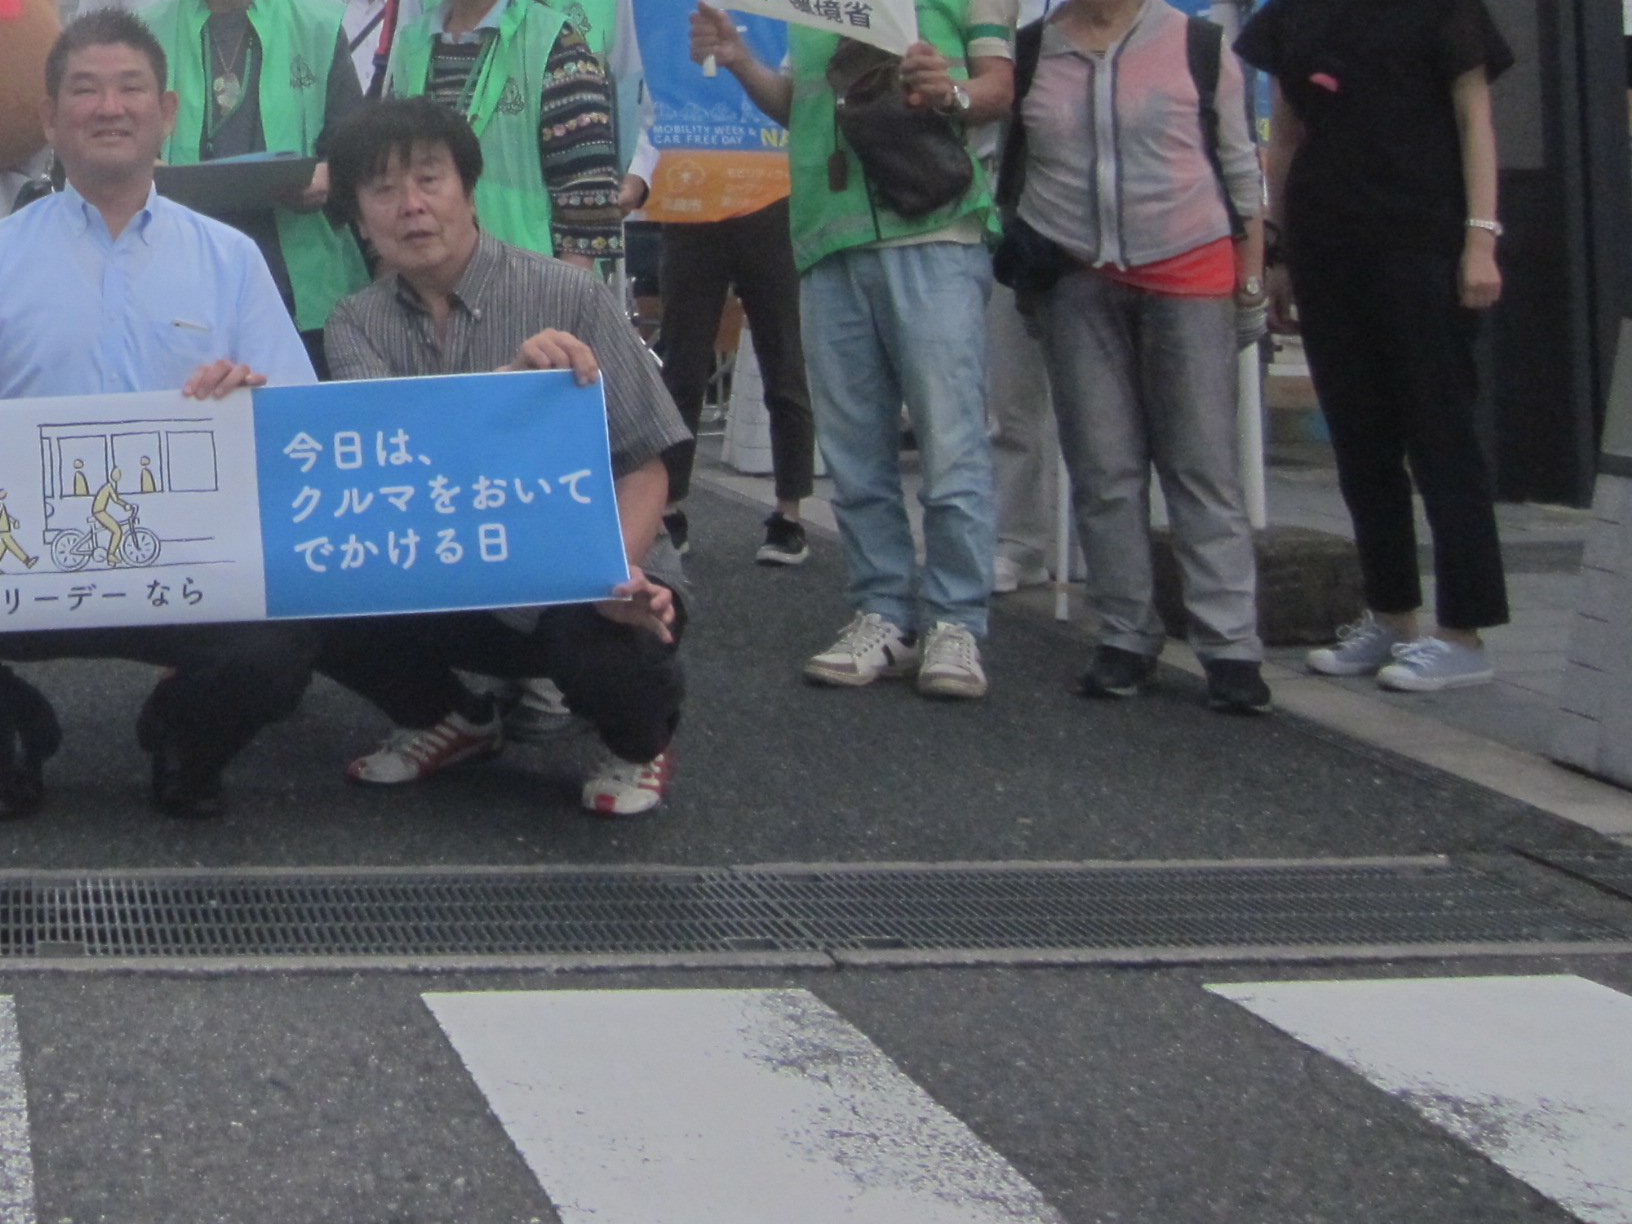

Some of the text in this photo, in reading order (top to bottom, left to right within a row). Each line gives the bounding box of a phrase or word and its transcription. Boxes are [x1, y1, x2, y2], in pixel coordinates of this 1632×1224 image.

[654, 135, 743, 144] CAR FREE DAY
[714, 126, 745, 135] WEEK
[283, 428, 431, 471] 今日は、
[290, 468, 594, 524] クルマをおいて
[293, 523, 508, 572] でかける日
